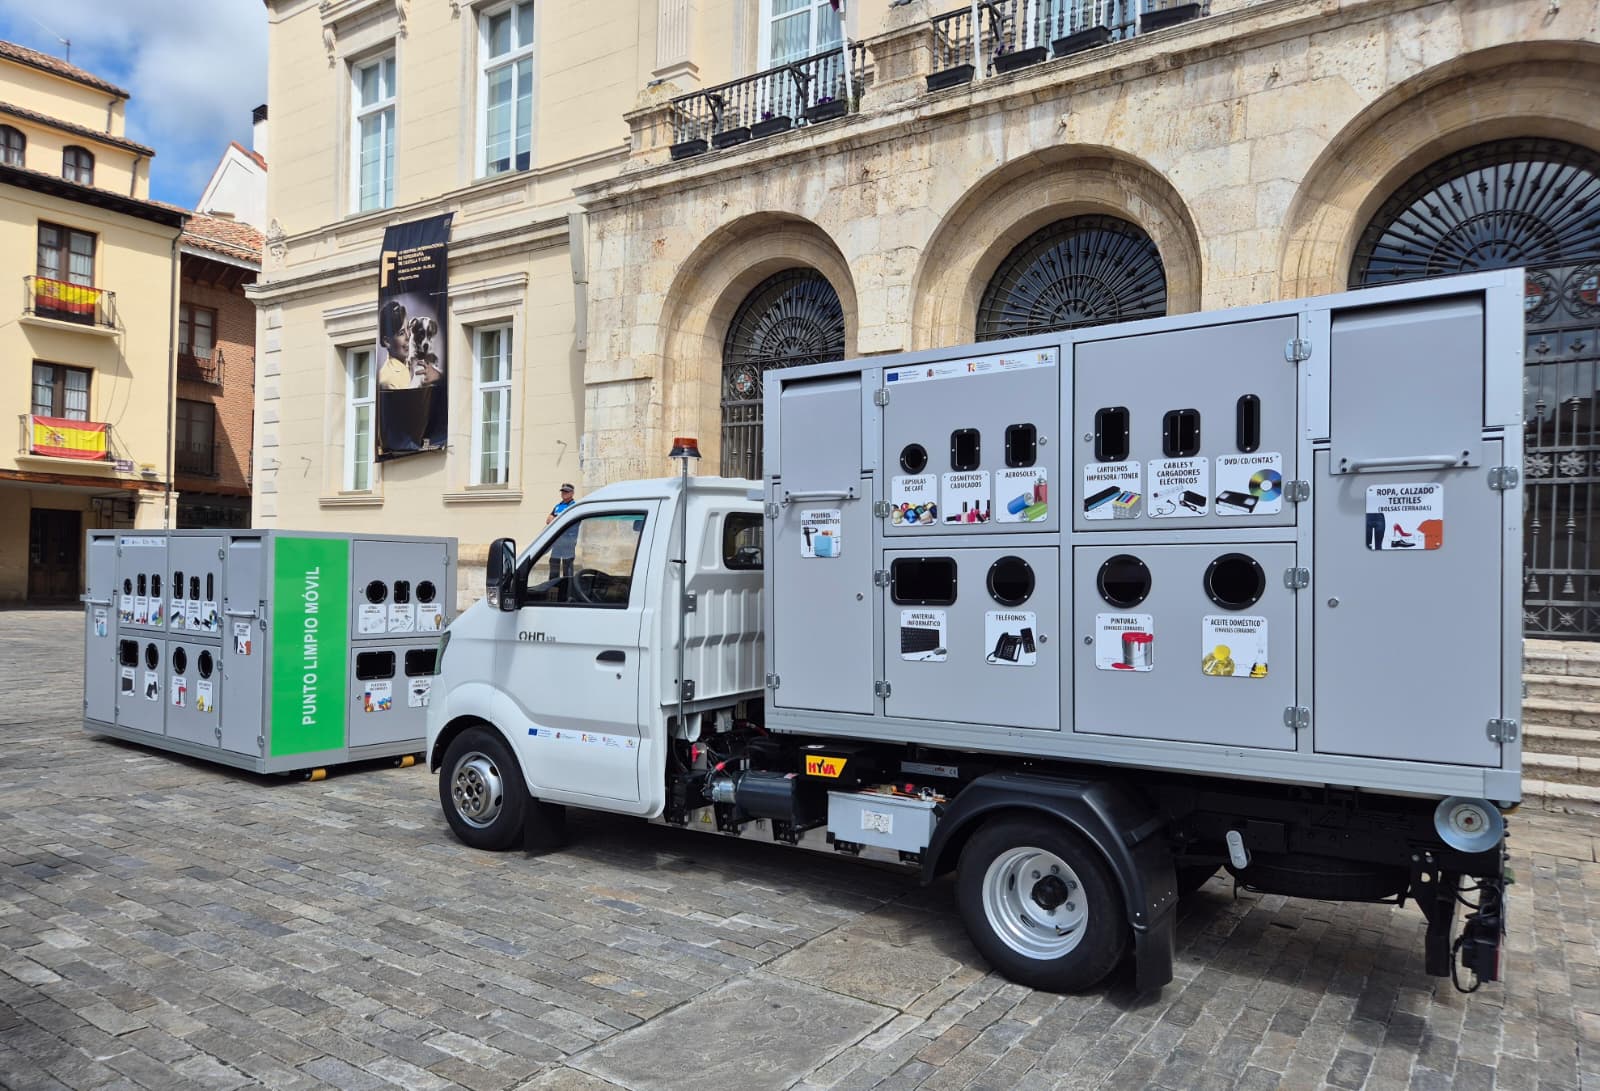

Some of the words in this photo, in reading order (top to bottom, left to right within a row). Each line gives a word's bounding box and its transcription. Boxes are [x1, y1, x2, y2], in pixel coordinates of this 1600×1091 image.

[381, 250, 398, 289] F
[1096, 465, 1128, 473] CARTUCHOS
[1156, 468, 1200, 478] CARGADORES
[950, 474, 982, 482] COSMÉTICOS
[1004, 470, 1037, 479] AEROSOLES
[1121, 472, 1139, 480] TONER
[1160, 476, 1198, 486] ELÉCTRICOS
[1376, 488, 1399, 496] ROPA,
[1400, 487, 1434, 496] CALZADO
[301, 566, 320, 614] MÓVIL
[1230, 618, 1261, 627] DOMÉSTICO
[304, 617, 318, 669] LIMPIO
[302, 673, 316, 726] PUNTO
[808, 759, 836, 775] HYVA
